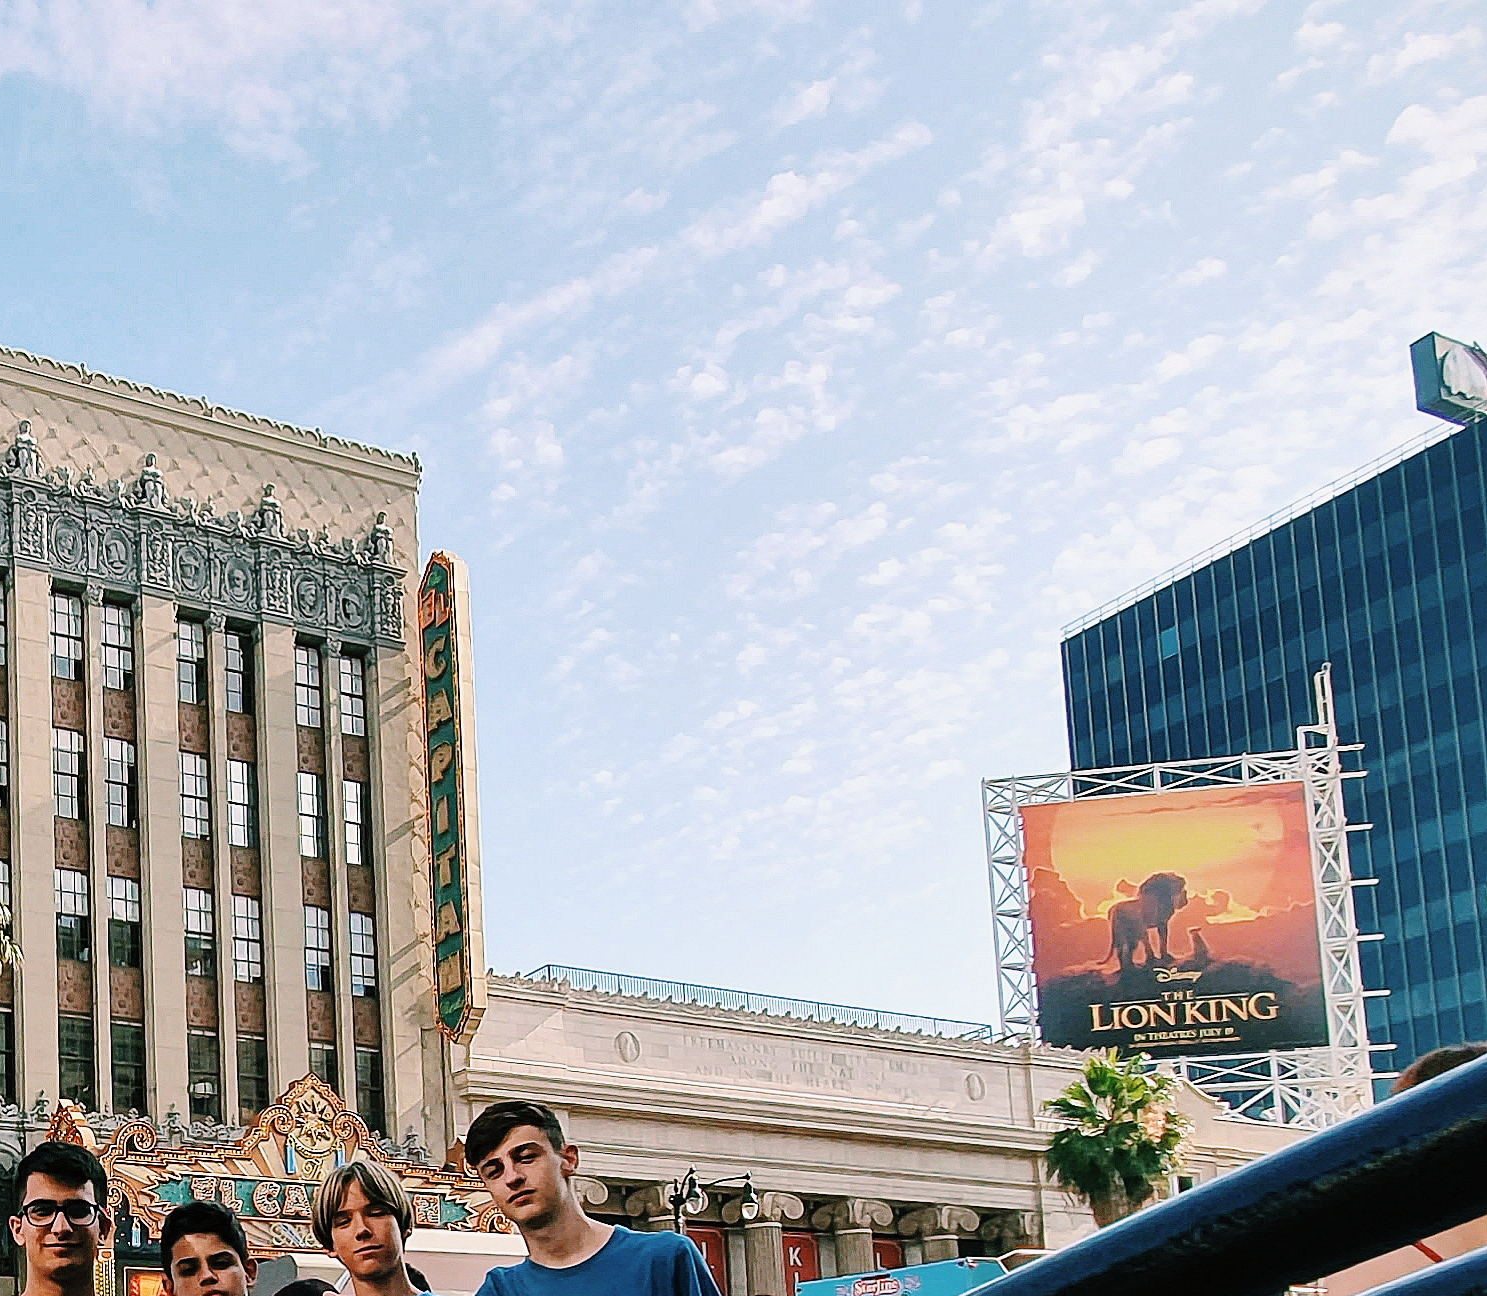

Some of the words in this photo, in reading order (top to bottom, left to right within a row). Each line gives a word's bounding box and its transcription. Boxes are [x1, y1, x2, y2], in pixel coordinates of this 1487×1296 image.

[419, 588, 450, 629] EL
[1089, 1002, 1178, 1032] LION
[1182, 992, 1279, 1025] KING
[1161, 990, 1194, 1001] THE
